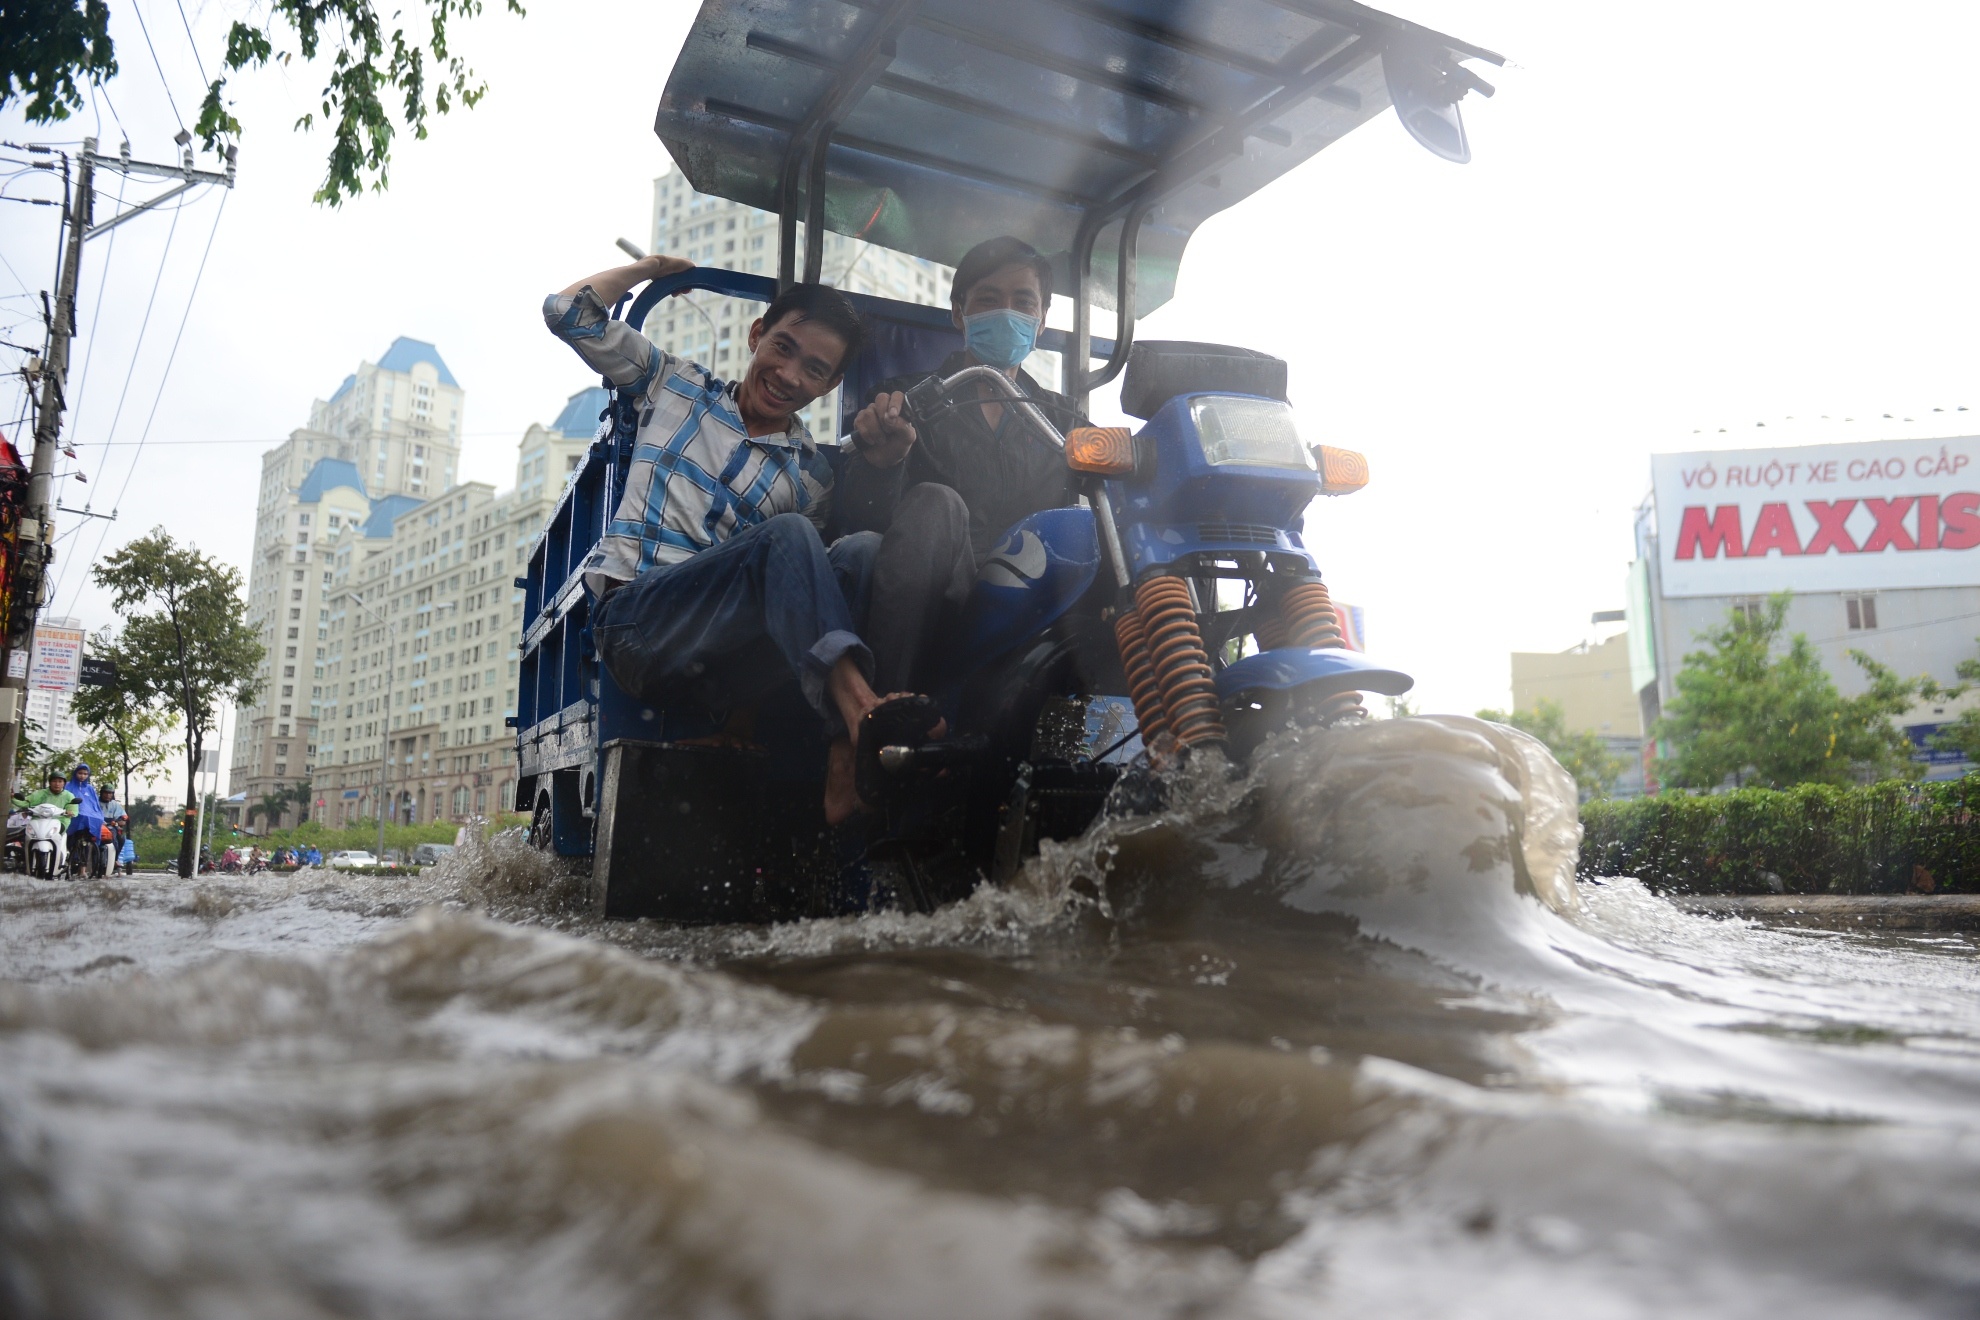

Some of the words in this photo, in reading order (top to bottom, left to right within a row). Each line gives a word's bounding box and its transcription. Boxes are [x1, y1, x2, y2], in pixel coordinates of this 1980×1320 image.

[1726, 459, 1802, 491] RUỘT
[1807, 461, 1839, 483] XE
[1847, 458, 1905, 481] CAO
[1674, 492, 1980, 561] MAXXIS
